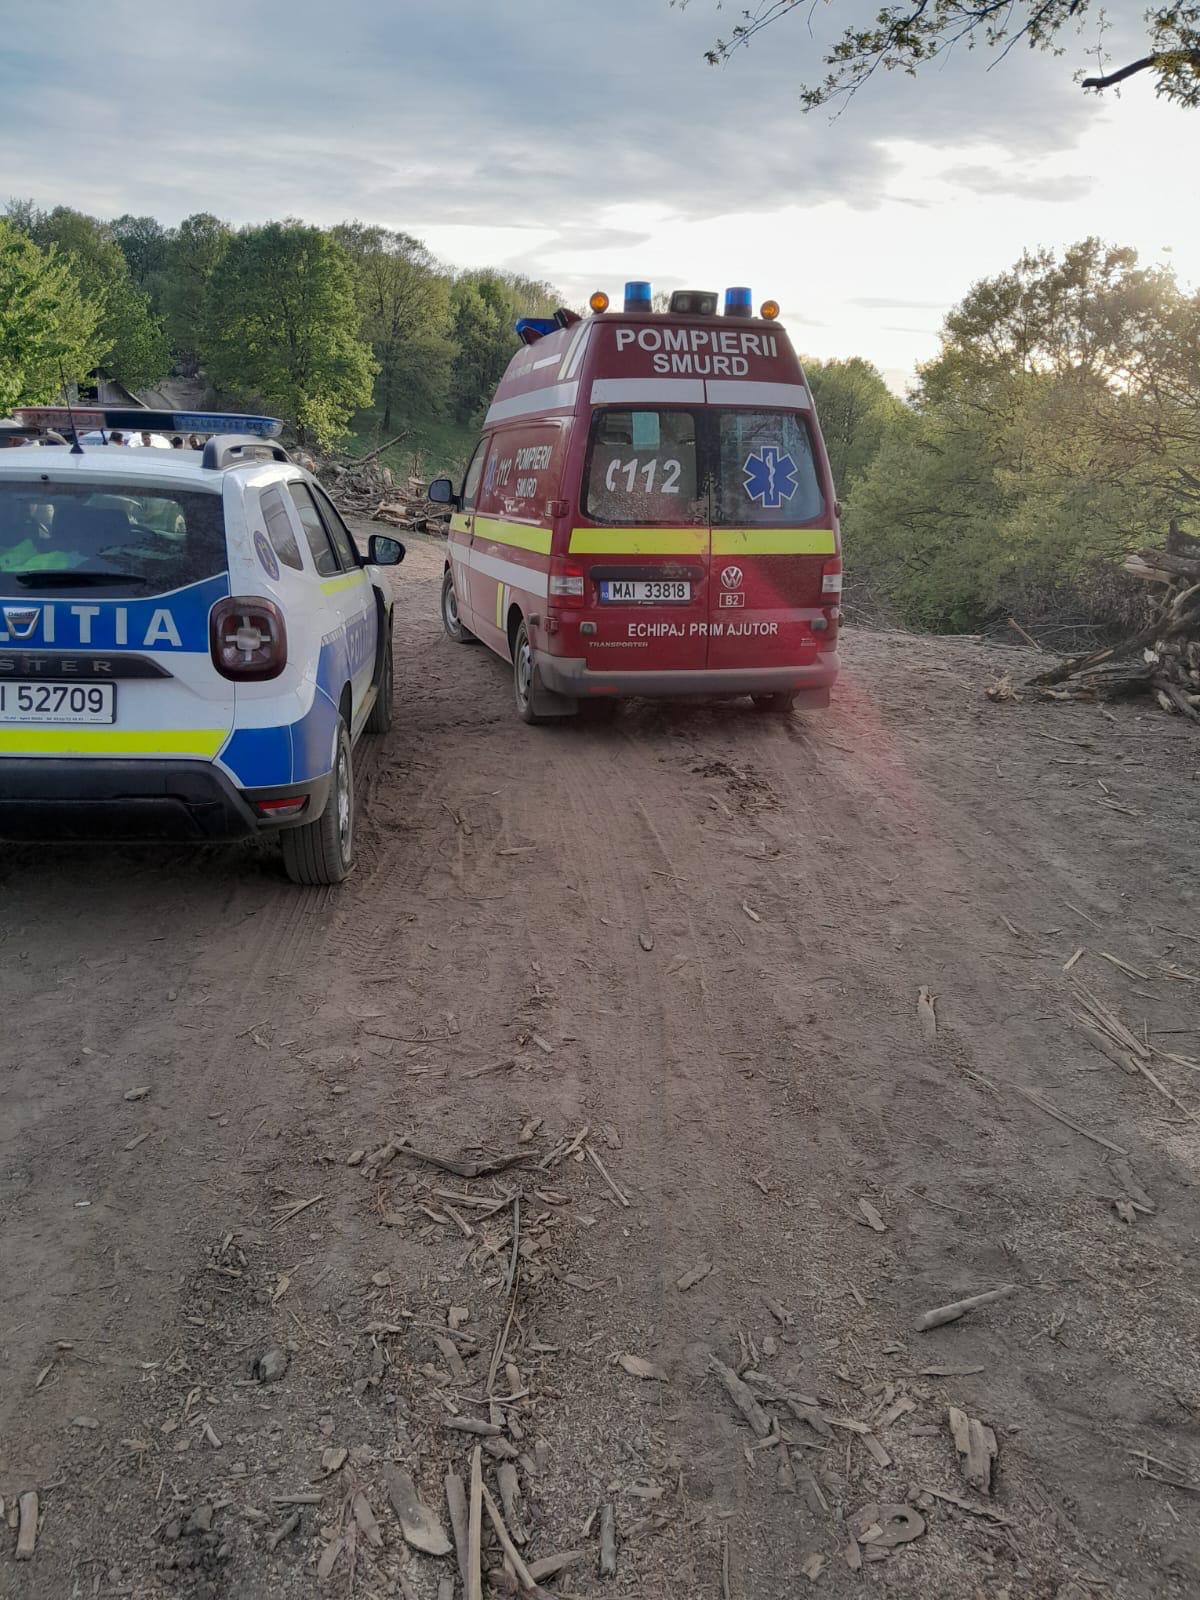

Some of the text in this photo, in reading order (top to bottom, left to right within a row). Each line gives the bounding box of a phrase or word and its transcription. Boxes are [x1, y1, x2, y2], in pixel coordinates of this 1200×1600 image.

[616, 328, 778, 358] POMPIERII
[653, 353, 749, 376] SMURD
[514, 446, 553, 472] POMPIERII
[515, 477, 538, 498] SMURD
[612, 583, 686, 598] MAI 33818
[725, 595, 739, 606] B2
[628, 622, 778, 637] ECHIPAJ PRIM AJUTOR
[18, 686, 104, 713] 52709
